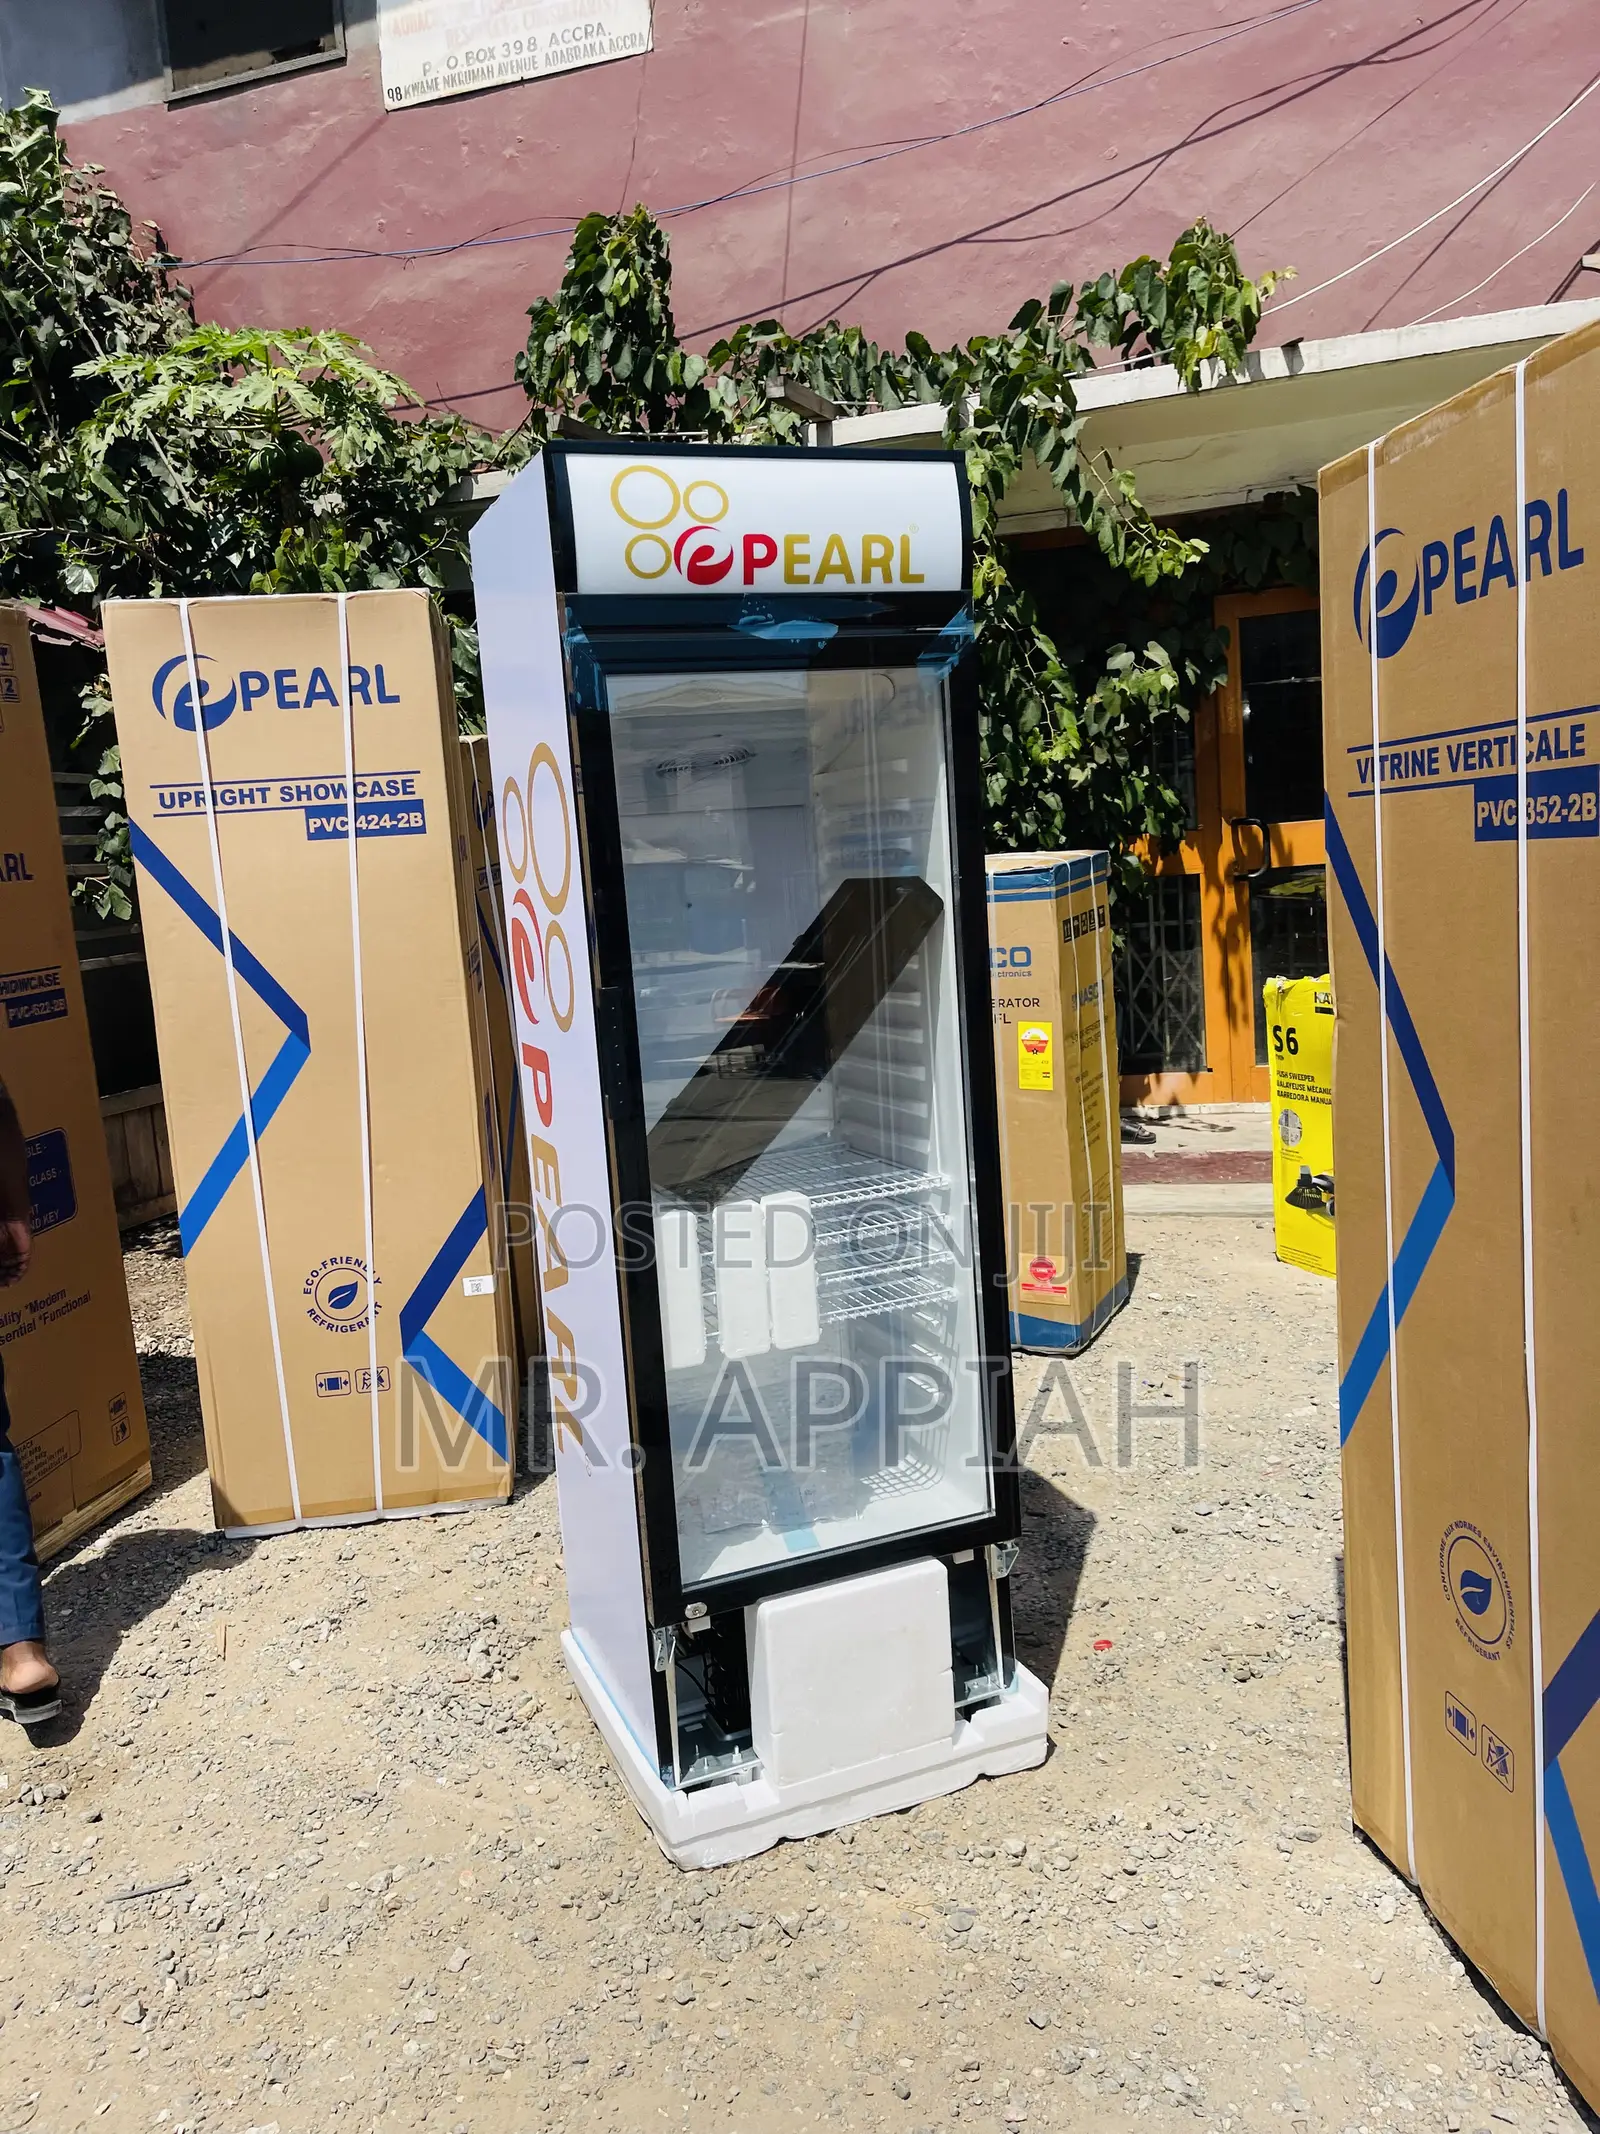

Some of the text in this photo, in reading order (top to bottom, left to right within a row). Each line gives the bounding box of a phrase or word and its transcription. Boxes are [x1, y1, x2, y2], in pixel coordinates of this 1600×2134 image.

[387, 86, 402, 102] 98
[403, 76, 440, 100] KWAME
[442, 64, 495, 90] NKRUMAH
[496, 56, 539, 79] AVENUE
[743, 533, 925, 586] PEARL
[1422, 488, 1585, 616] PEARL
[239, 663, 401, 712] PEARL
[1356, 723, 1586, 784] VITRINE VERTICALE
[158, 778, 416, 809] UPRIGHT SHOWCASE
[1289, 1072, 1316, 1083] SWEEPER
[521, 1042, 584, 1455] PEARL
[1443, 1523, 1454, 1540] AUX
[1454, 1519, 1482, 1539] NORMES
